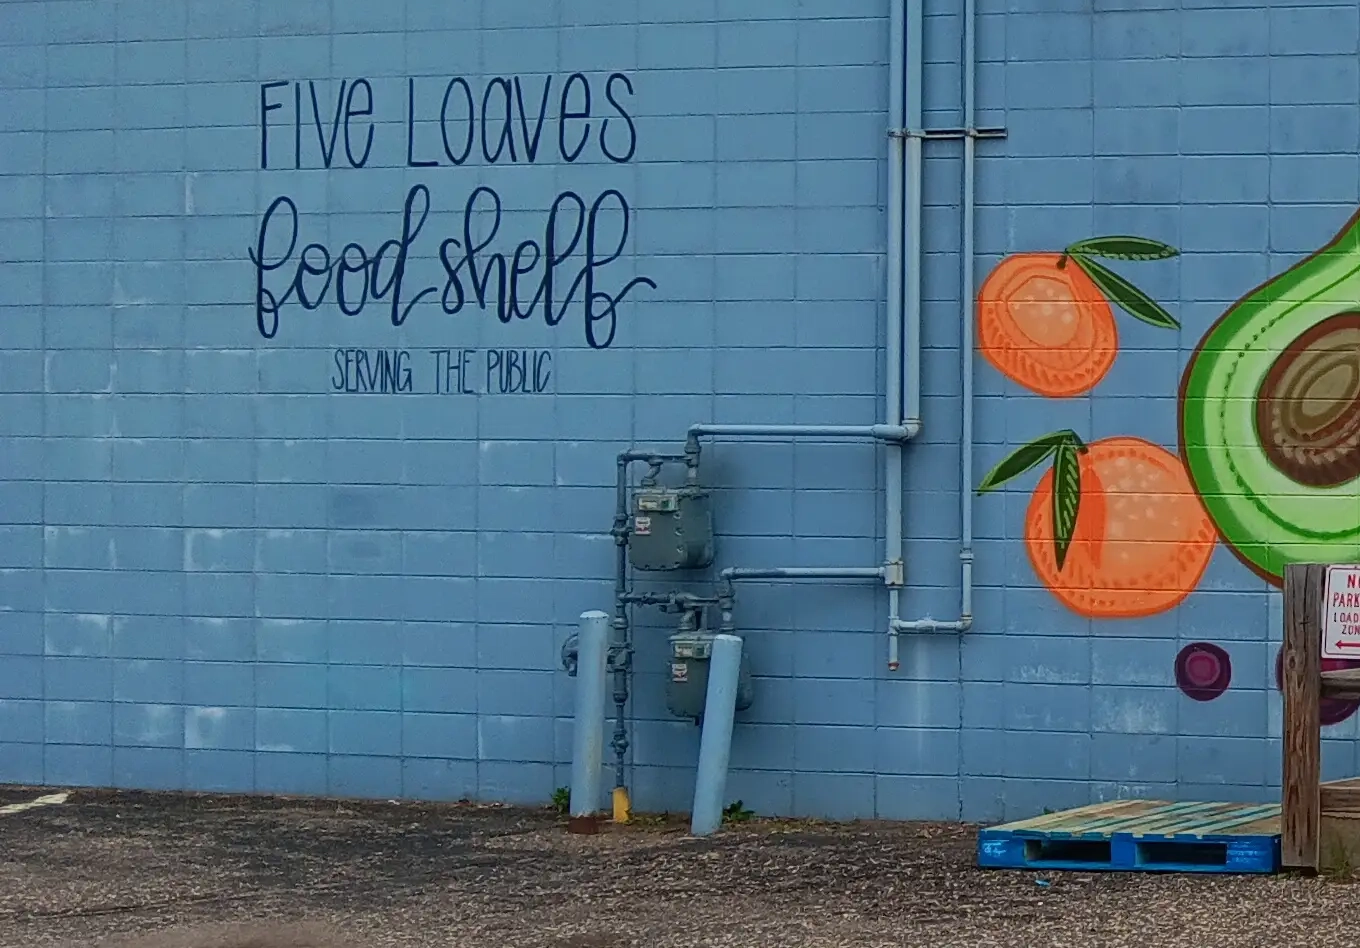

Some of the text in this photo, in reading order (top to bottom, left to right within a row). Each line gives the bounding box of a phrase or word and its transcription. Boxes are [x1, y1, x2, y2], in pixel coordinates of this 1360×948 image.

[248, 184, 657, 349] food shelf
[332, 348, 553, 394] SERVING THE PUBLIC
